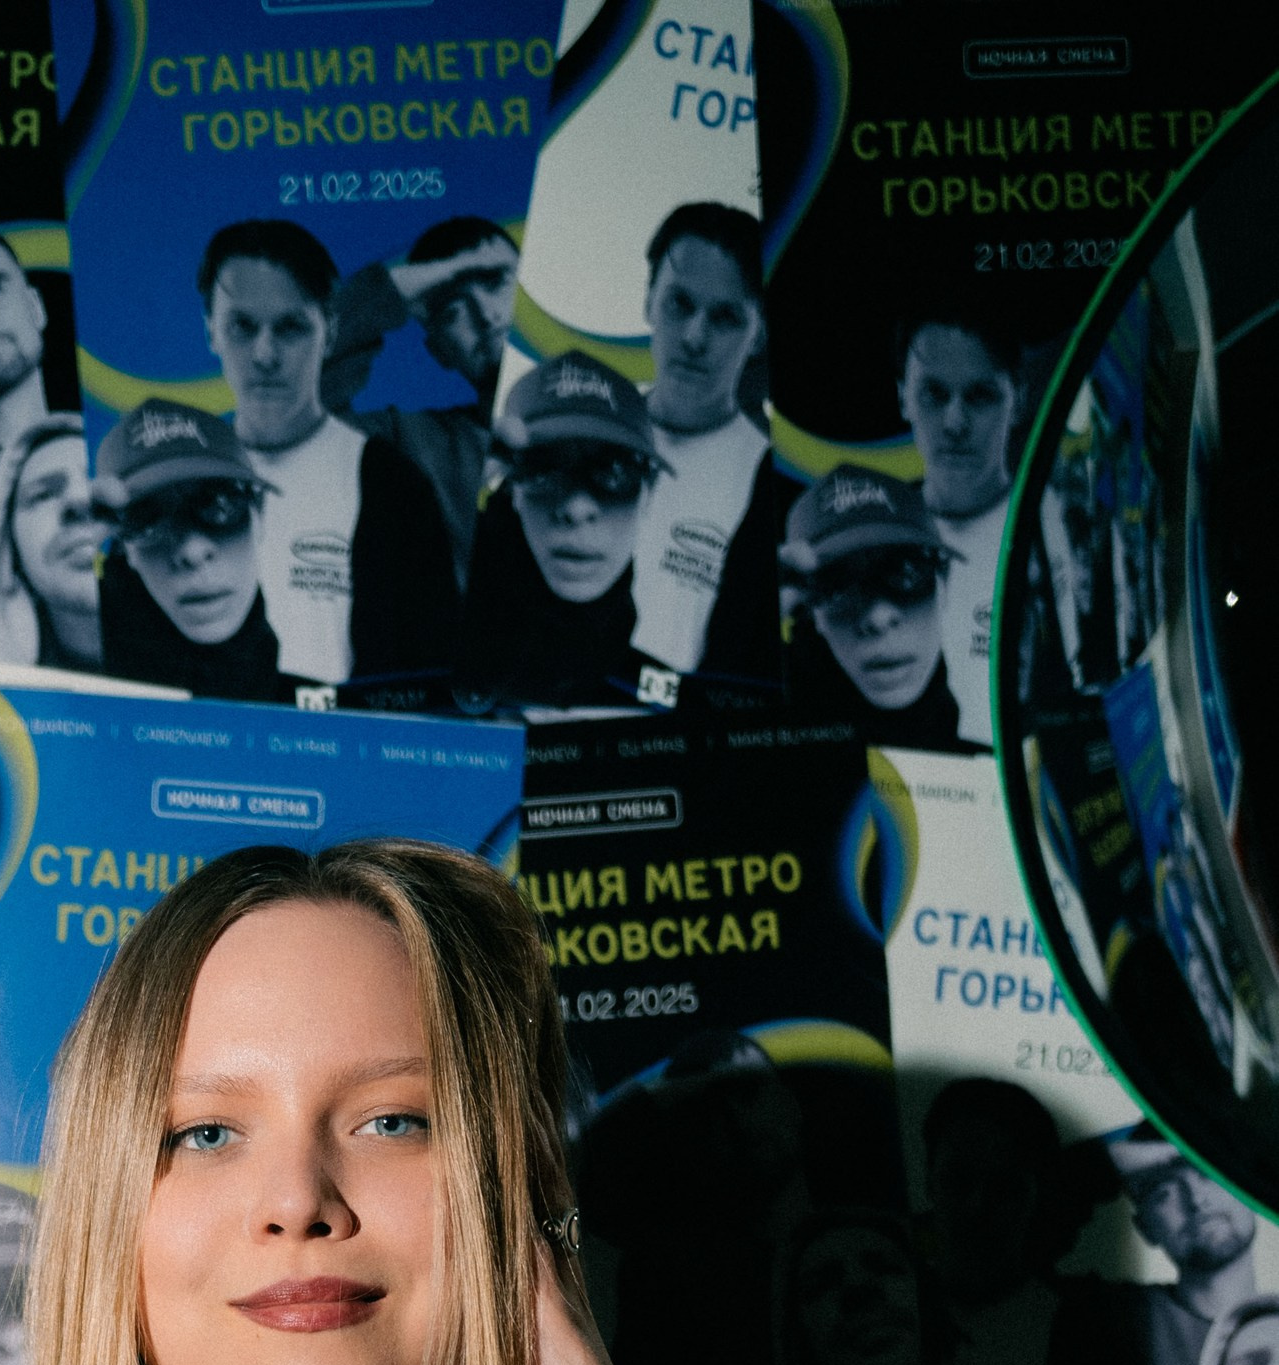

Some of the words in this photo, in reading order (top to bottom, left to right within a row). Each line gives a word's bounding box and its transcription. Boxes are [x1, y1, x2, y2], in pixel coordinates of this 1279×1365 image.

[149, 45, 377, 97] СТАНЦИЯ
[394, 37, 556, 83] МЕТРО
[182, 97, 531, 152] ГОРЬКОВСКАЯ
[850, 113, 1073, 162] СТАНЦИЯ
[279, 168, 447, 205] 21.02.2025
[166, 790, 241, 812] НОЧНАЯ
[247, 797, 310, 818] СМЕНА
[527, 804, 599, 827] НОЧНАЯ
[606, 798, 667, 821] СМЕНА
[644, 852, 802, 905] МЕТРО
